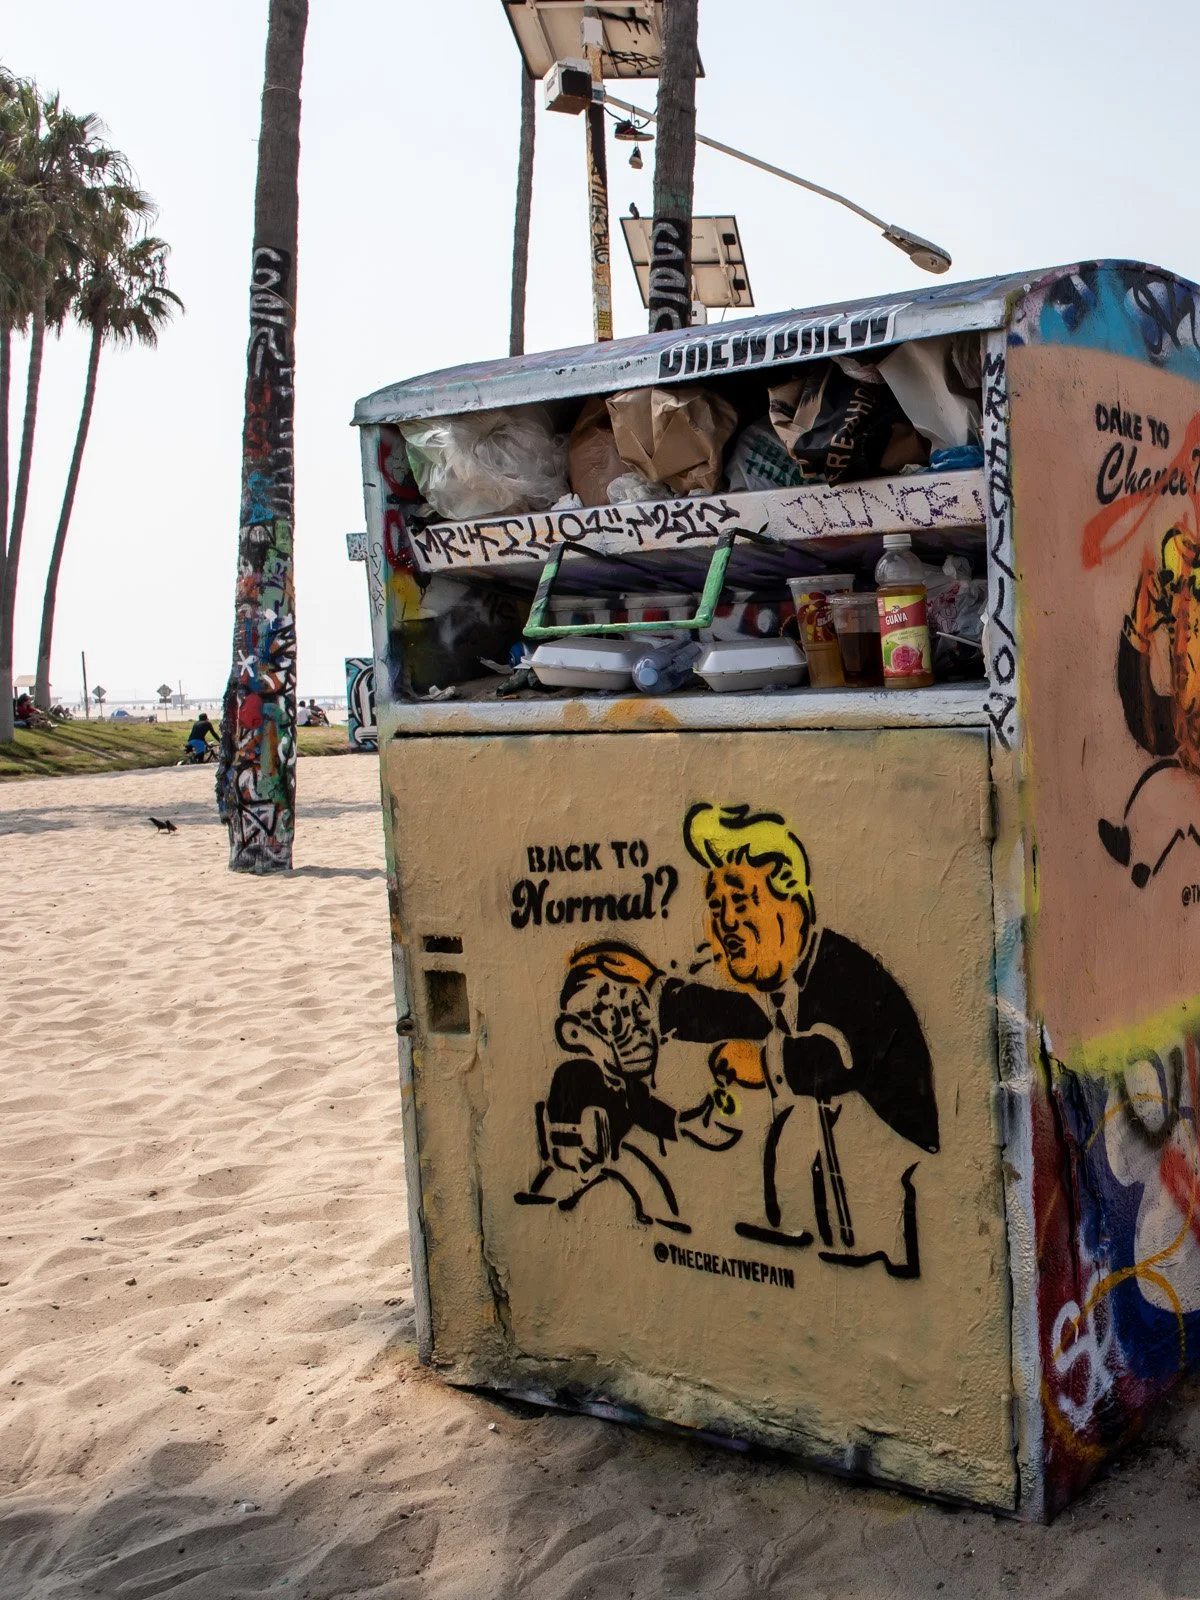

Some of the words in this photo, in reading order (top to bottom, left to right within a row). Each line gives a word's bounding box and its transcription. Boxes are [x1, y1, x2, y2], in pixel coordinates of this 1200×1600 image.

[1094, 401, 1143, 442] DARE
[1146, 414, 1171, 449] TO
[885, 612, 908, 625] GUAVA
[526, 843, 603, 873] BACK
[610, 840, 649, 869] TO
[510, 865, 679, 929] Normal?
[654, 1241, 796, 1290] @THECREATIVEPAIN
